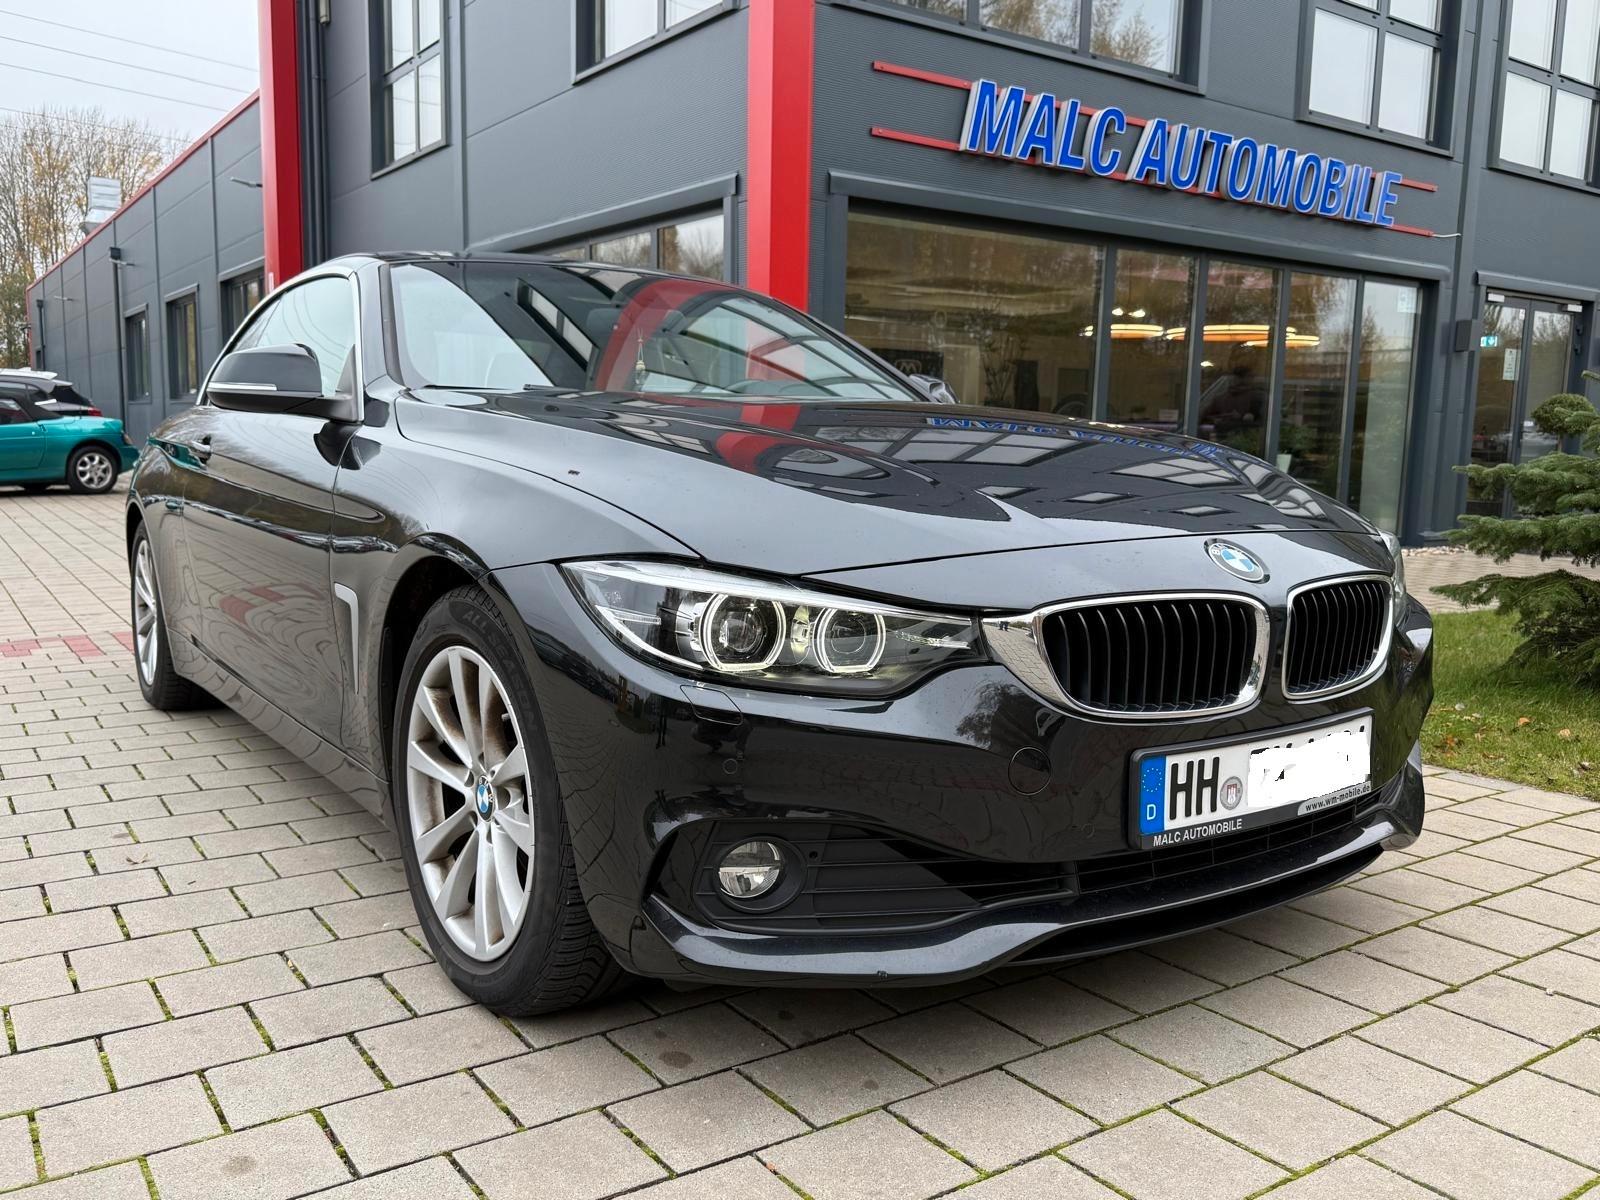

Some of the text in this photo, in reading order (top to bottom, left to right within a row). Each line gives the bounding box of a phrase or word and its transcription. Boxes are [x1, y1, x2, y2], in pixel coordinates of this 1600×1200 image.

[961, 78, 1403, 227] MALC AUTOMOBILE
[462, 610, 538, 731] ALL SEASON
[1169, 756, 1220, 820] HH
[1305, 784, 1371, 812] www.wm-mobile.de
[1146, 803, 1157, 820] D
[1153, 818, 1242, 847] MALC AUTOMOBILE
